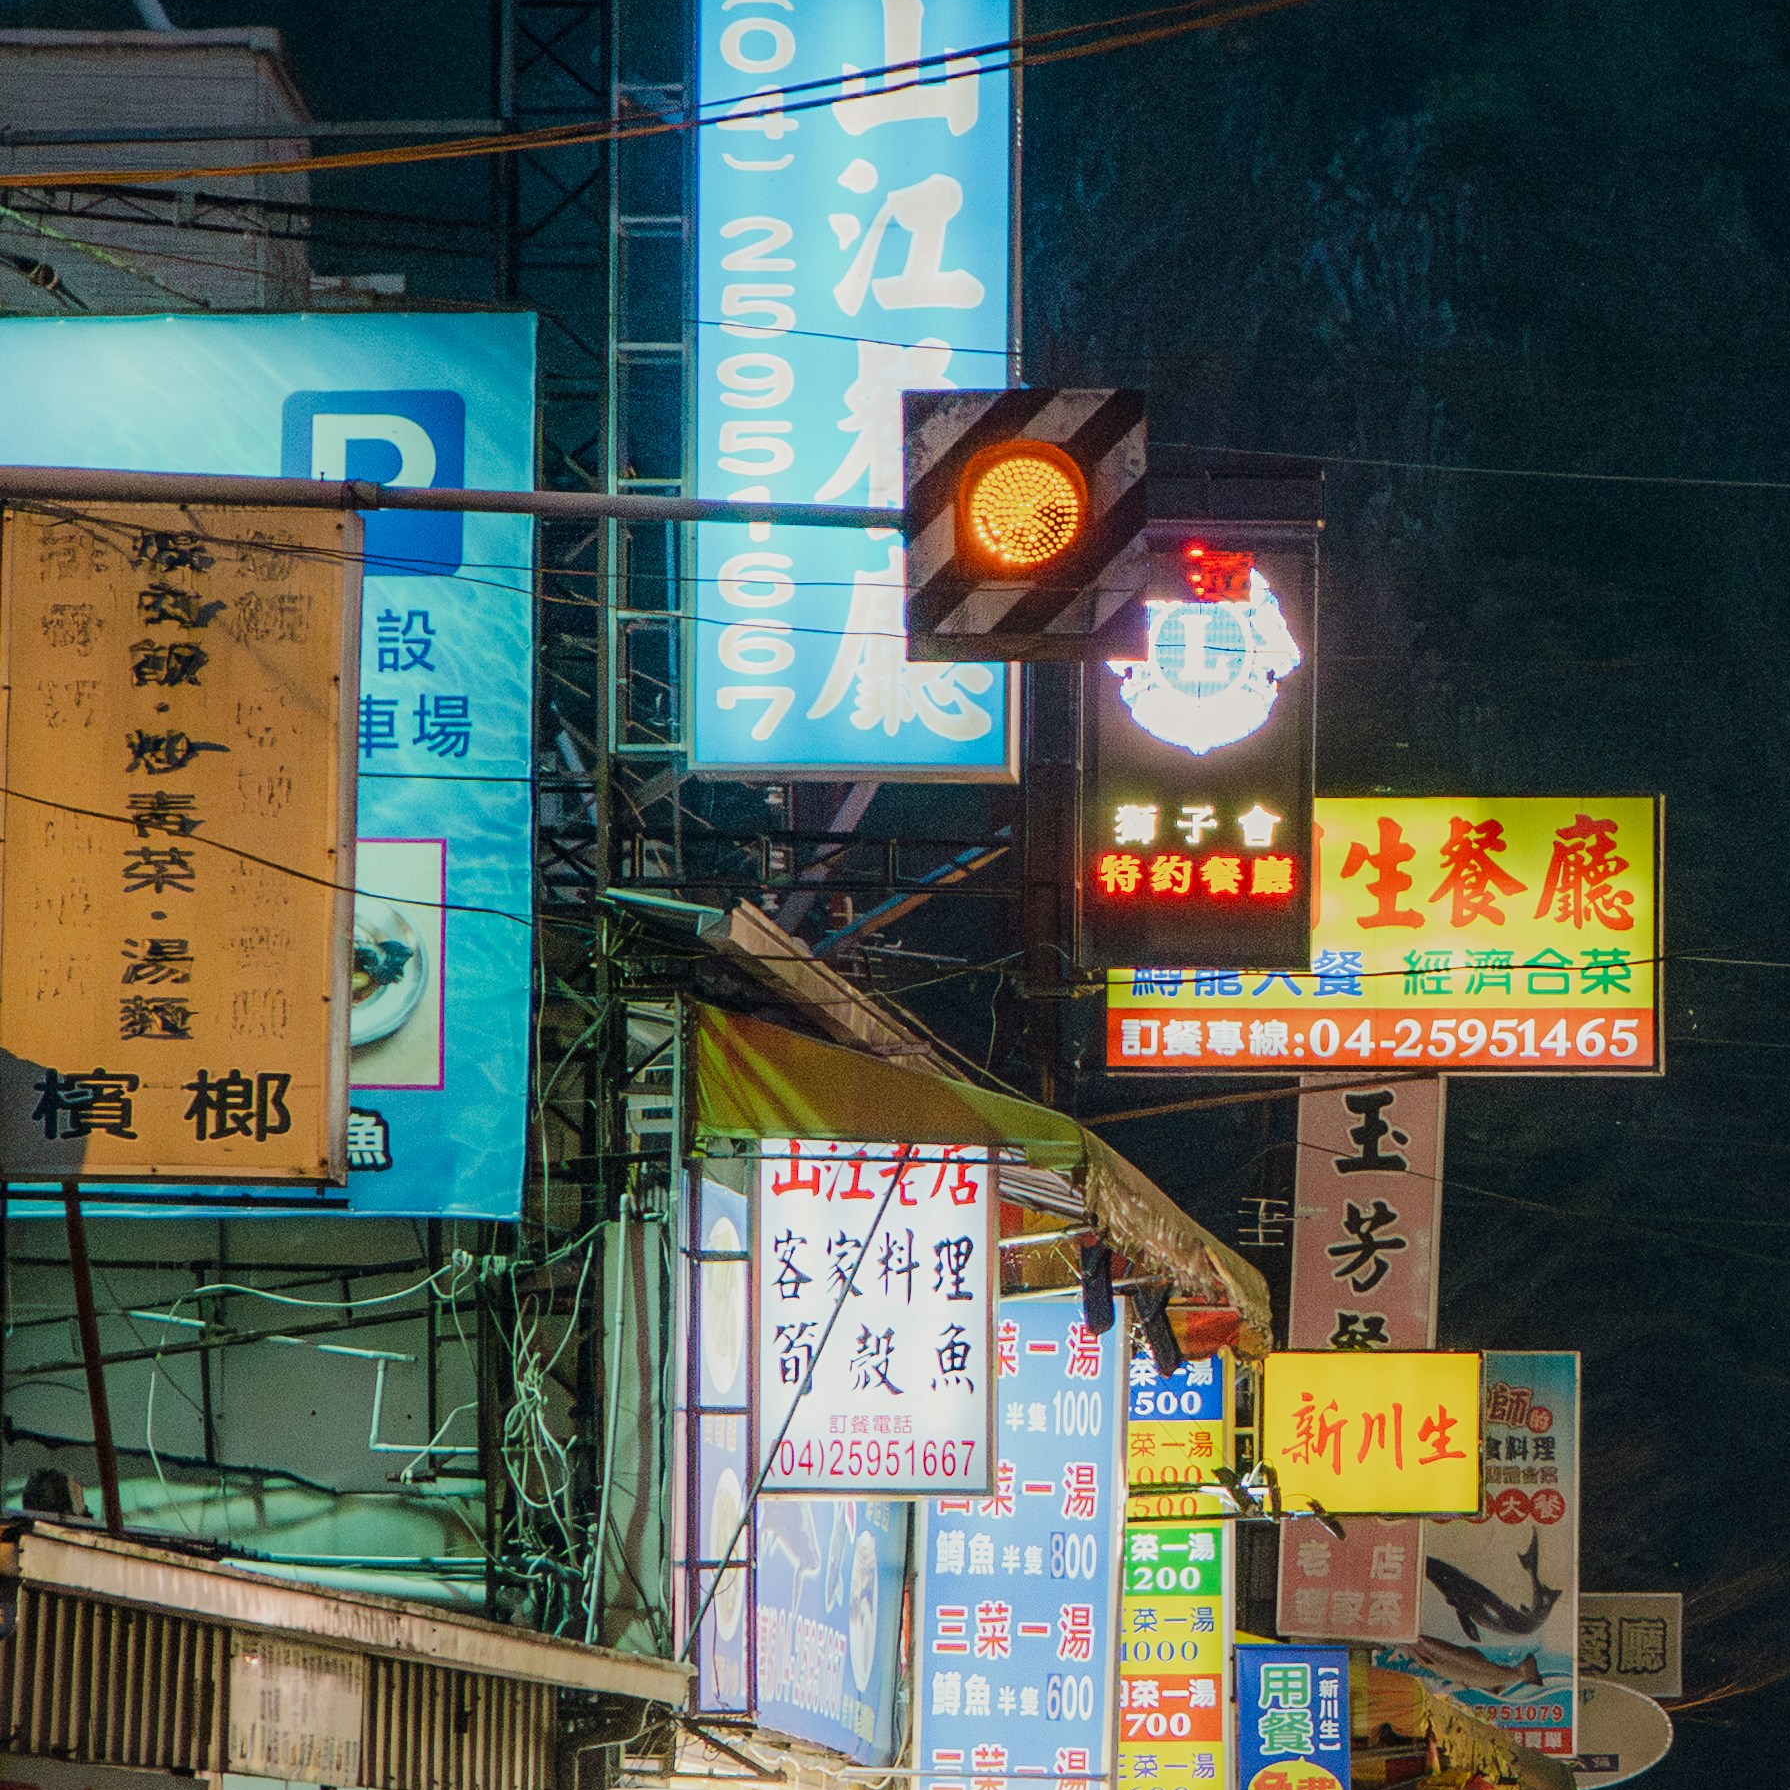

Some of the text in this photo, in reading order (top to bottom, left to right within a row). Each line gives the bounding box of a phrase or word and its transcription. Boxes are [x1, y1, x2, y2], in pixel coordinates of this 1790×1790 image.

[1114, 805, 1283, 847] 獅子會
[1100, 854, 1294, 895] 特約餐廳
[1312, 814, 1636, 932] 生餐廳
[1403, 948, 1632, 997] 經濟合菜
[31, 1067, 294, 1143] 檳榔
[771, 1139, 980, 1207] 山江老店
[771, 1228, 975, 1306] 客家料理
[771, 1321, 975, 1396] 筍殼魚
[829, 1414, 913, 1435] 訂餐電話
[1128, 1390, 1202, 1416] 500
[1282, 1392, 1467, 1476] 新川生
[769, 1441, 976, 1477] (04)25951667
[1124, 1532, 1216, 1562] 菜一湯
[932, 1600, 1096, 1662] 三菜一湯
[1122, 1606, 1215, 1633] 菜一湯
[1125, 1713, 1192, 1738] 700
[1258, 1662, 1315, 1756] 用餐
